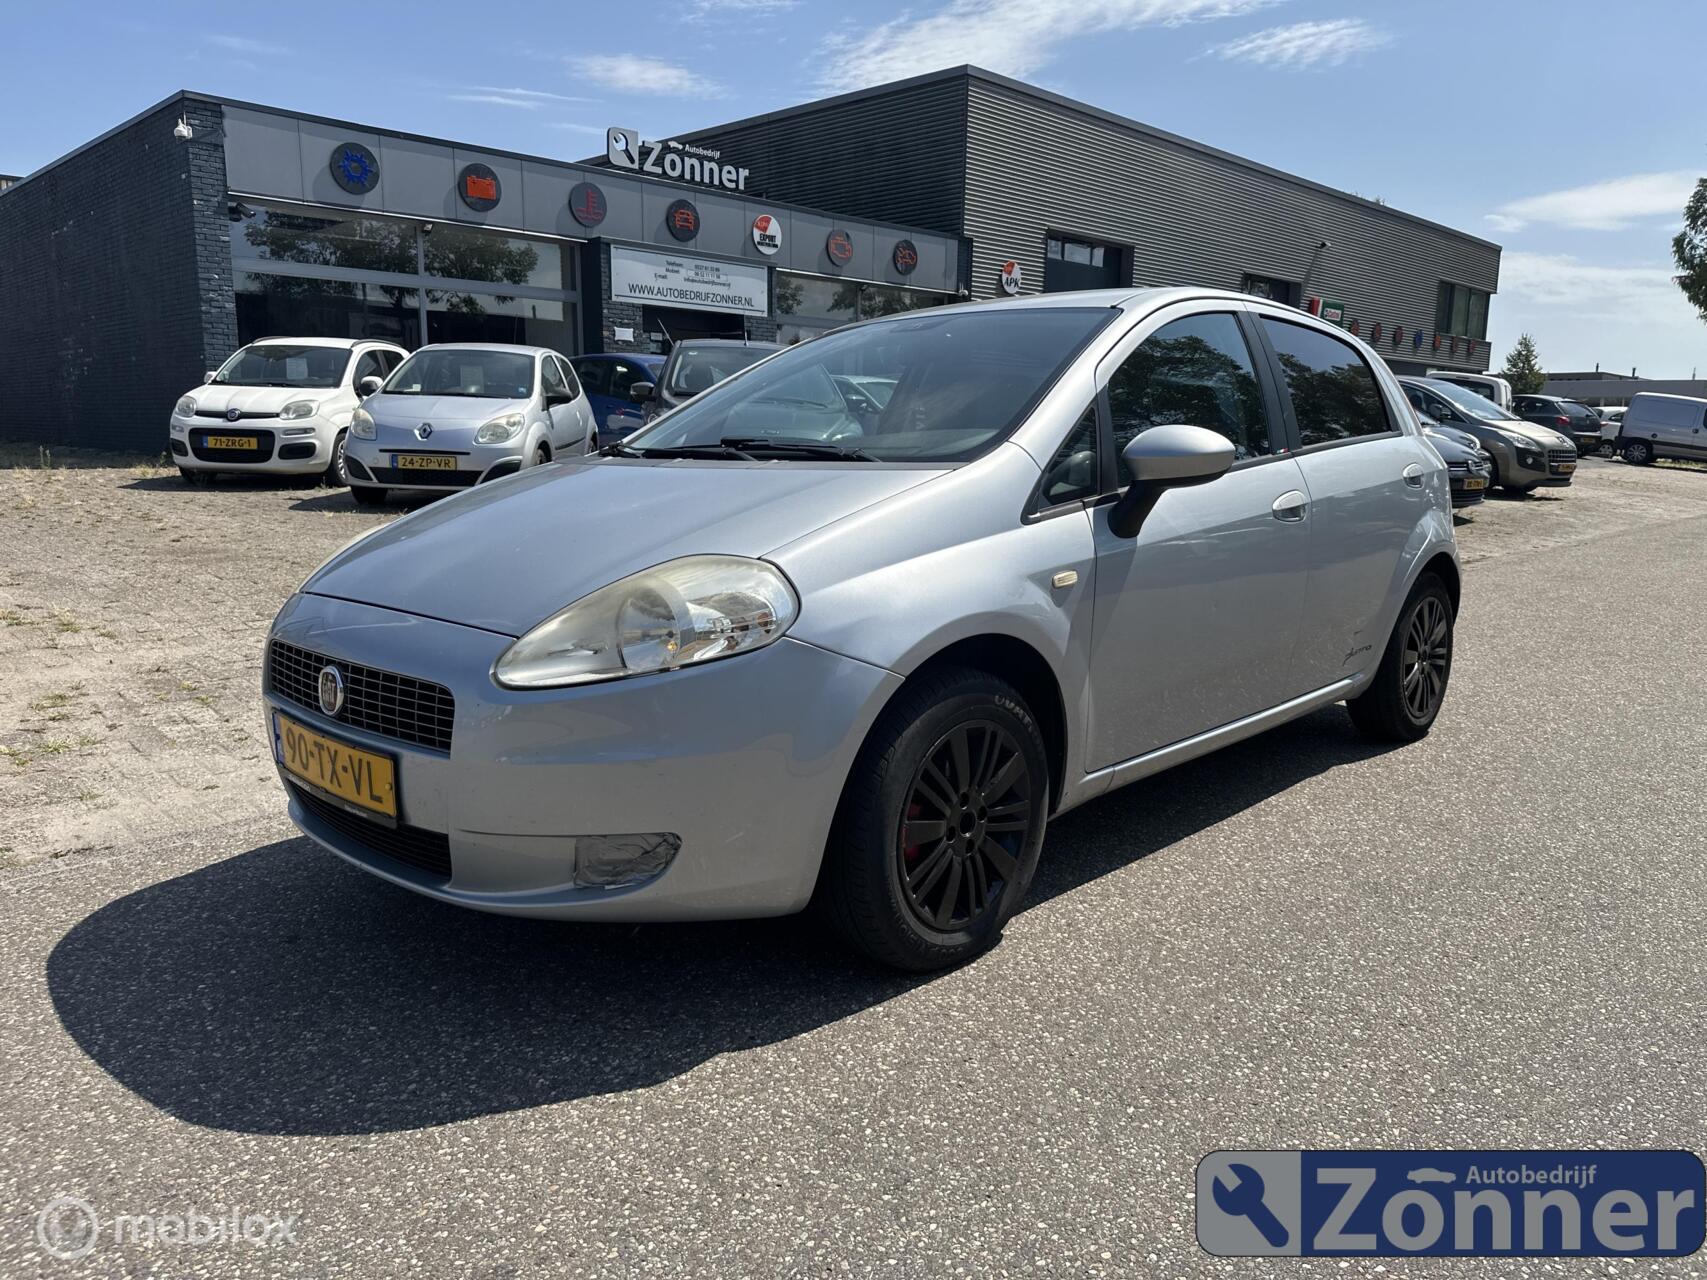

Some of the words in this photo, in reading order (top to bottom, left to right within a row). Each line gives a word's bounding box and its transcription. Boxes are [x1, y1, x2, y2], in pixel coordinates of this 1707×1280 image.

[684, 143, 721, 159] Autobedrijf
[643, 140, 750, 190] Zonner
[1004, 277, 1020, 288] APK
[628, 283, 755, 308] WWW.AUTOBEDRIJFZONNER.NL
[401, 456, 452, 469] 24-ZP-VR
[285, 727, 384, 804] 90-TX-VL
